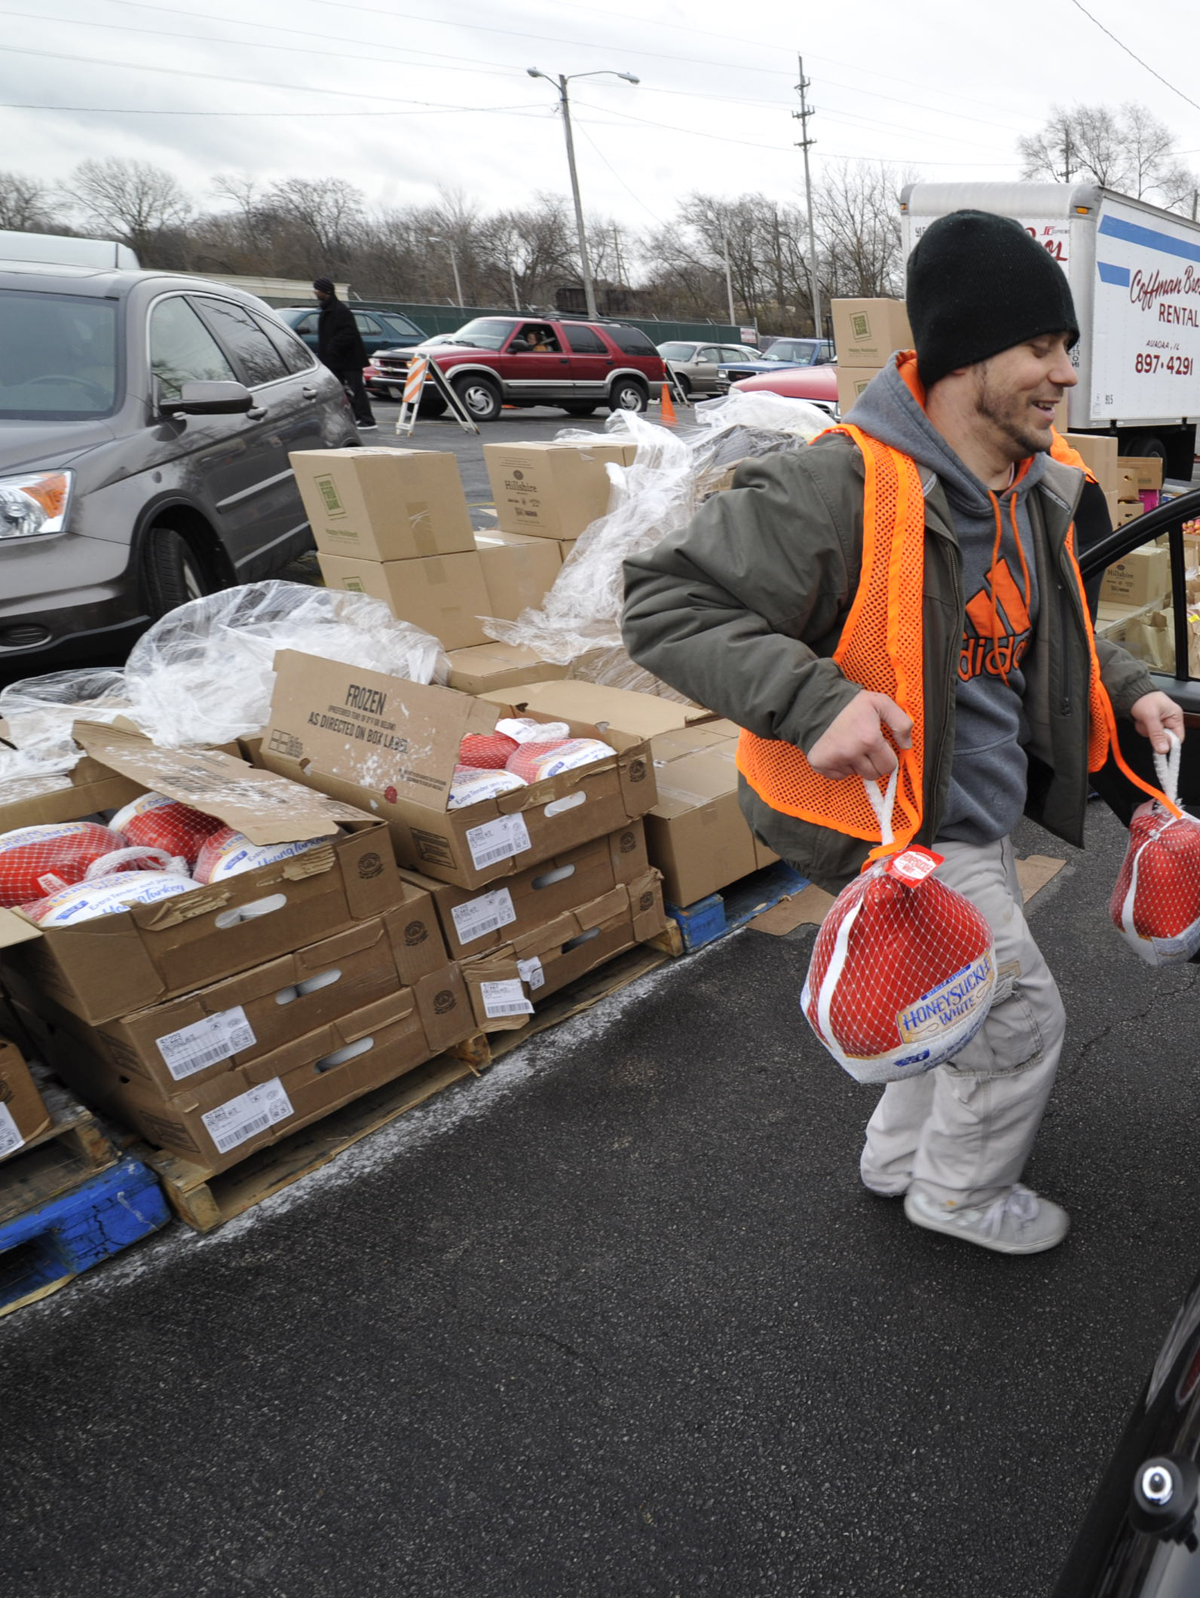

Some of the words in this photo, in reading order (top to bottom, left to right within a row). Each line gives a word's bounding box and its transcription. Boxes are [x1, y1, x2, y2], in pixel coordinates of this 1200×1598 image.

[1130, 269, 1182, 312] Coffman
[1158, 302, 1199, 328] RENTAL
[504, 480, 538, 493] Hillshire
[1107, 569, 1134, 579] Hillshire
[345, 684, 387, 716] FROZEN
[307, 711, 320, 726] AS
[320, 715, 355, 736] DIRECTED
[355, 725, 366, 740] ON
[367, 729, 384, 745] BOX
[383, 733, 408, 753] LABEL
[903, 956, 991, 1031] HONEYSUCKLE
[939, 996, 977, 1025] WHITE
